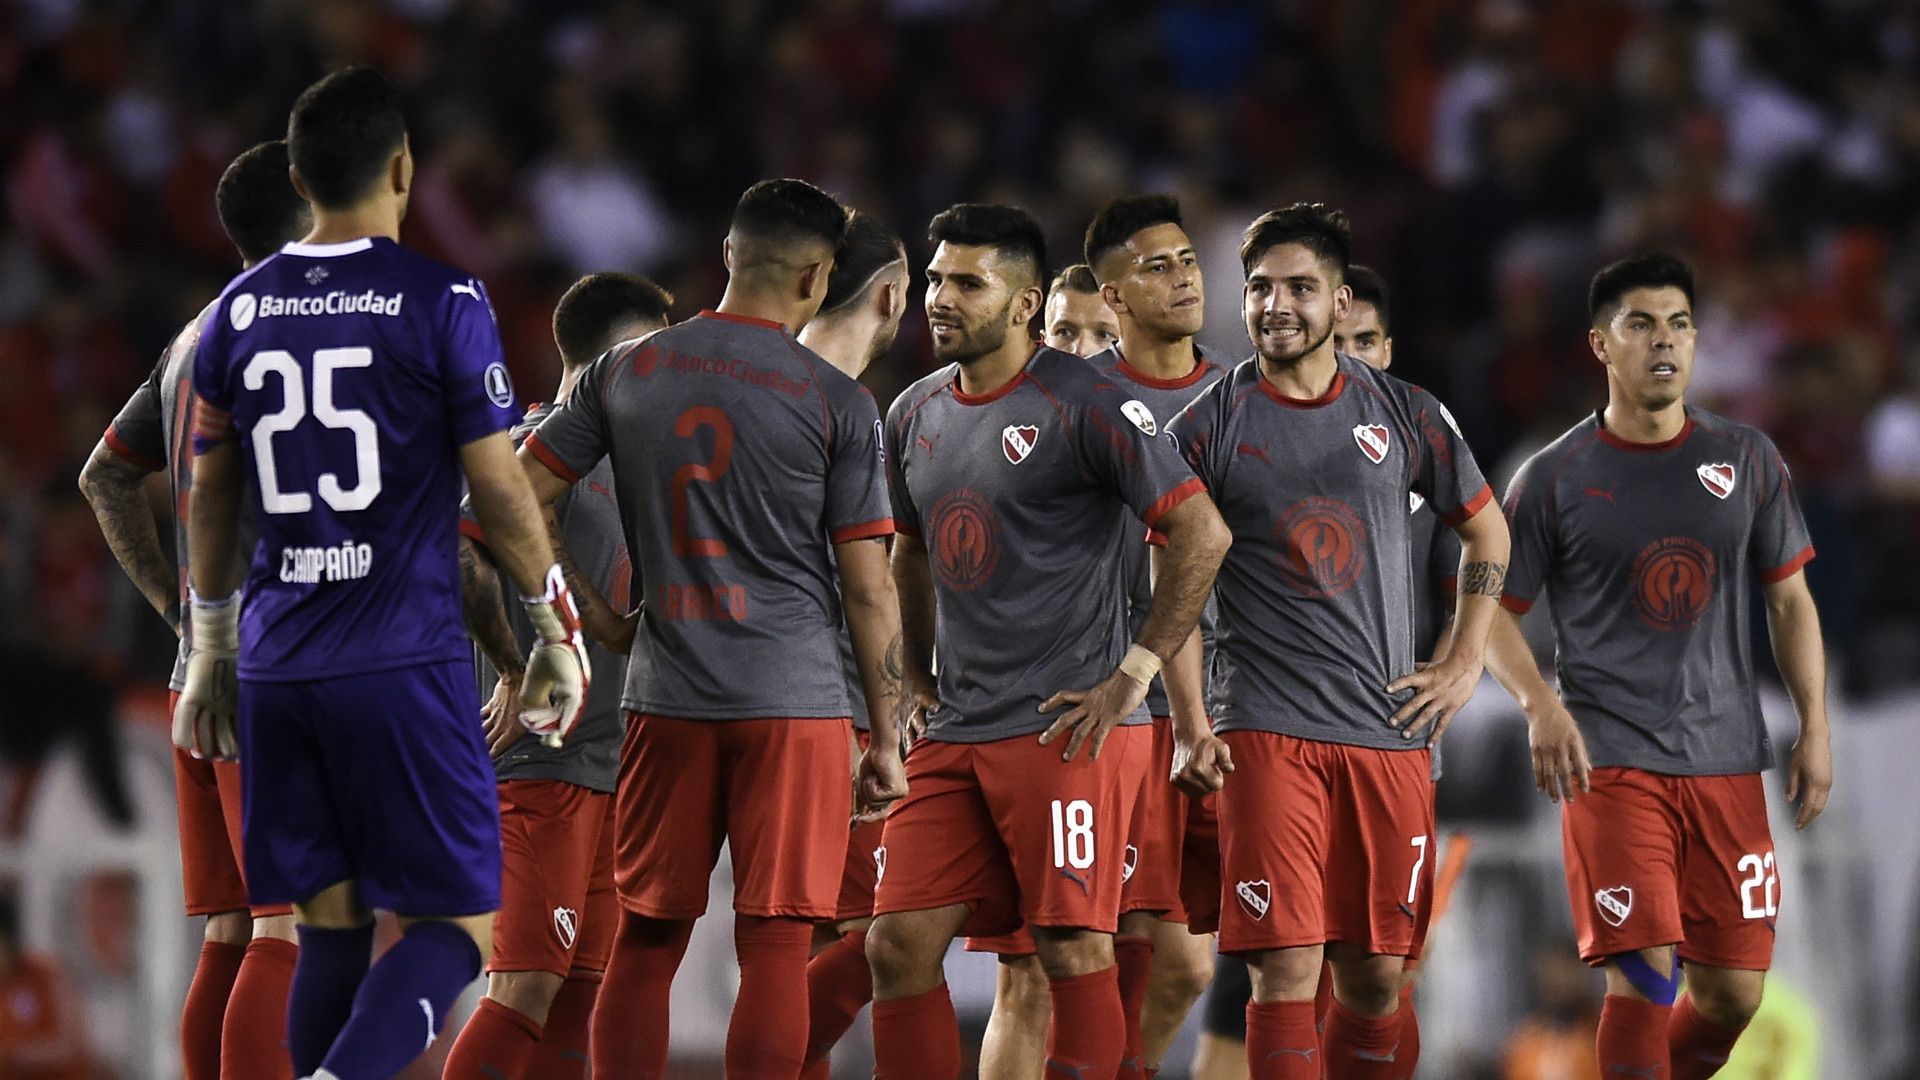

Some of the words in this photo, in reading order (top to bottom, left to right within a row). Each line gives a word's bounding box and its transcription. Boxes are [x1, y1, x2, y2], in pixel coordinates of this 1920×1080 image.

[258, 289, 403, 319] BancoCiudad
[243, 346, 383, 515] 25
[671, 405, 735, 558] 2
[279, 539, 374, 584] CAMPAÑA
[1051, 799, 1095, 870] 18
[1409, 835, 1428, 906] 7
[1738, 853, 1777, 920] 22
